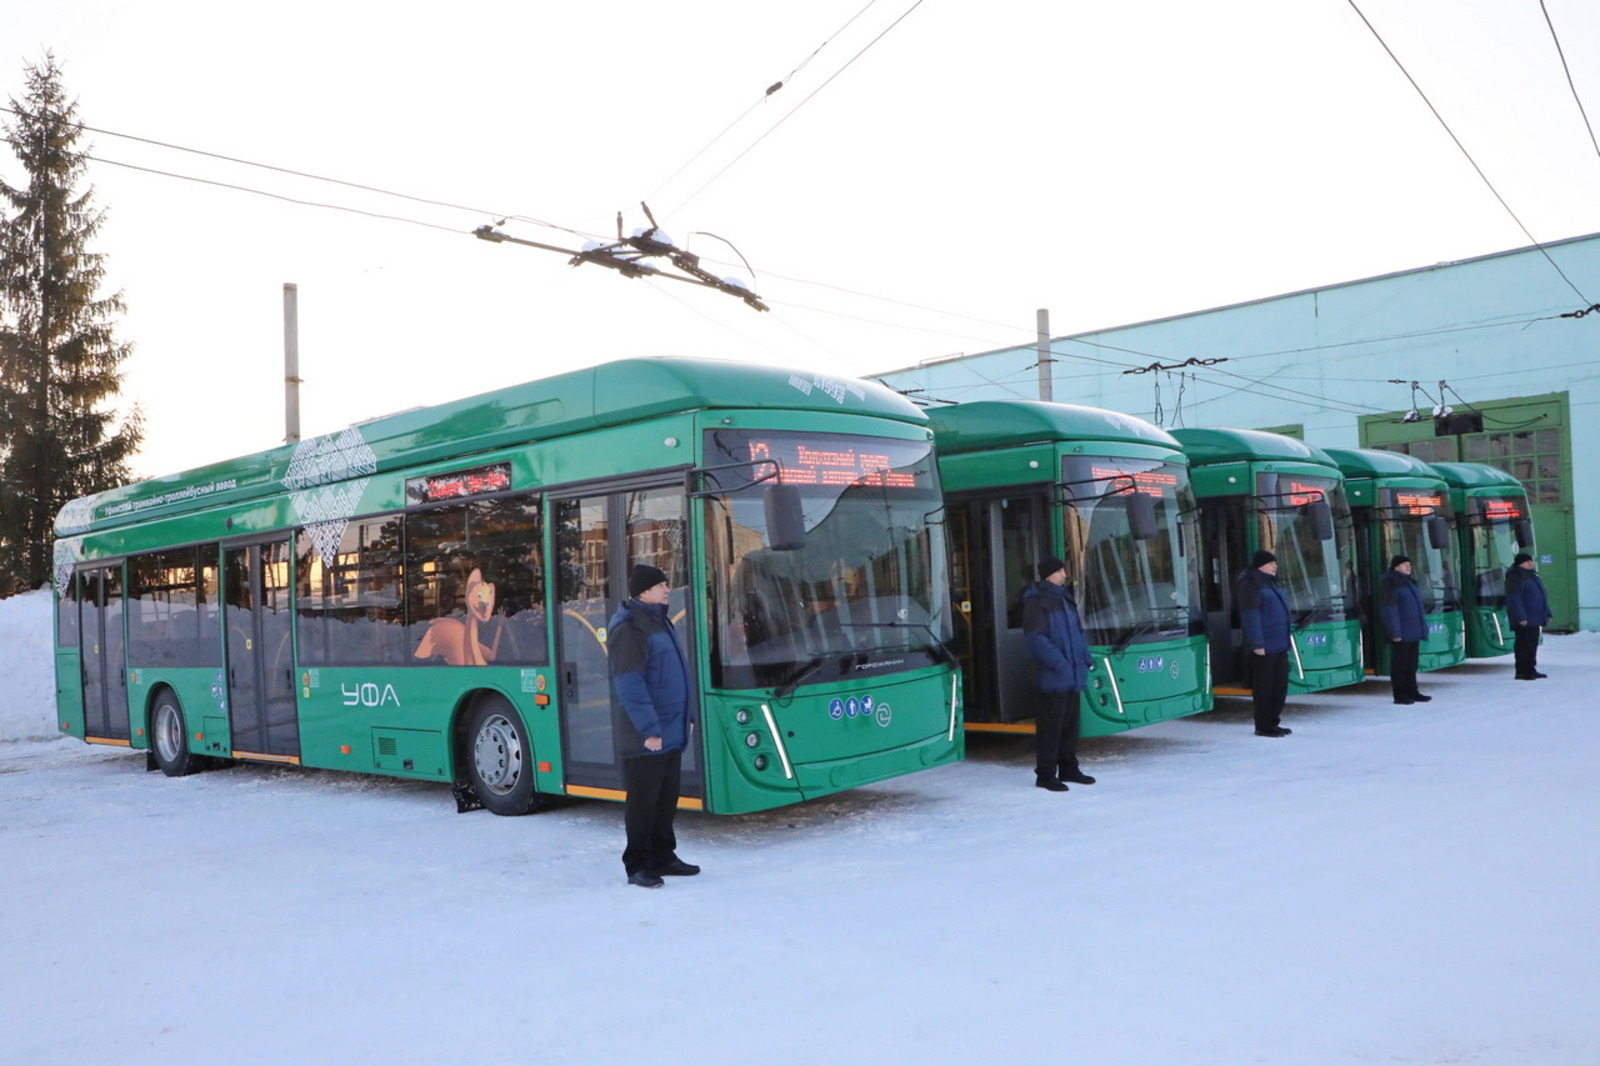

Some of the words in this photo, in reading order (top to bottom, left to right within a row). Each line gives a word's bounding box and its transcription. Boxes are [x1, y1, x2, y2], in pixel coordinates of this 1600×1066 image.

[105, 501, 132, 516] Уфимский
[215, 479, 237, 492] завод
[341, 682, 401, 708] УФА
